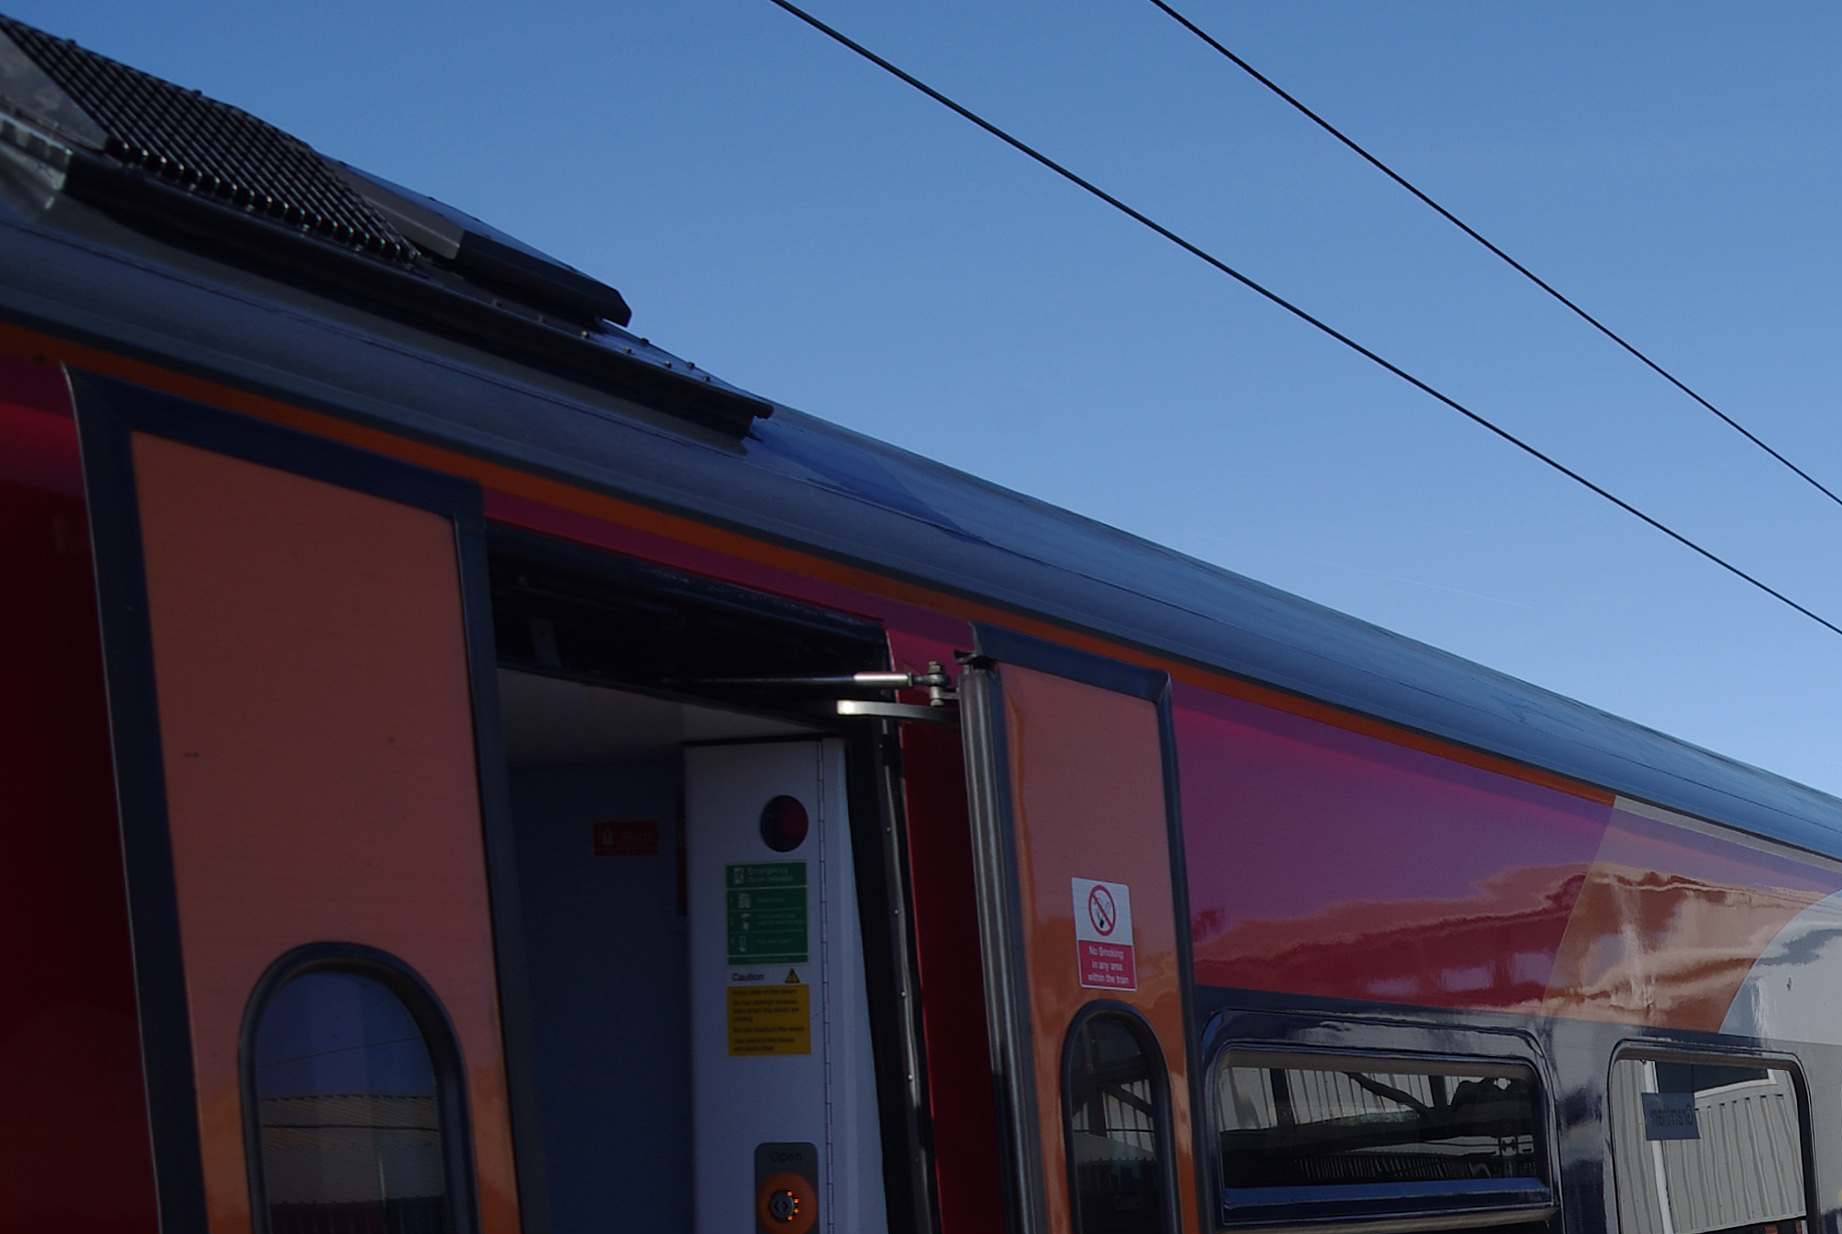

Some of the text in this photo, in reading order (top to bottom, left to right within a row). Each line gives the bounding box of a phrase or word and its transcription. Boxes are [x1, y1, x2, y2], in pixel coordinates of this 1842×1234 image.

[1088, 945, 1124, 961] No Smoking
[1098, 961, 1109, 972] any
[1110, 962, 1123, 971] area
[732, 972, 765, 981] Caution
[1087, 972, 1130, 984] within the train
[769, 1151, 803, 1163] Open
